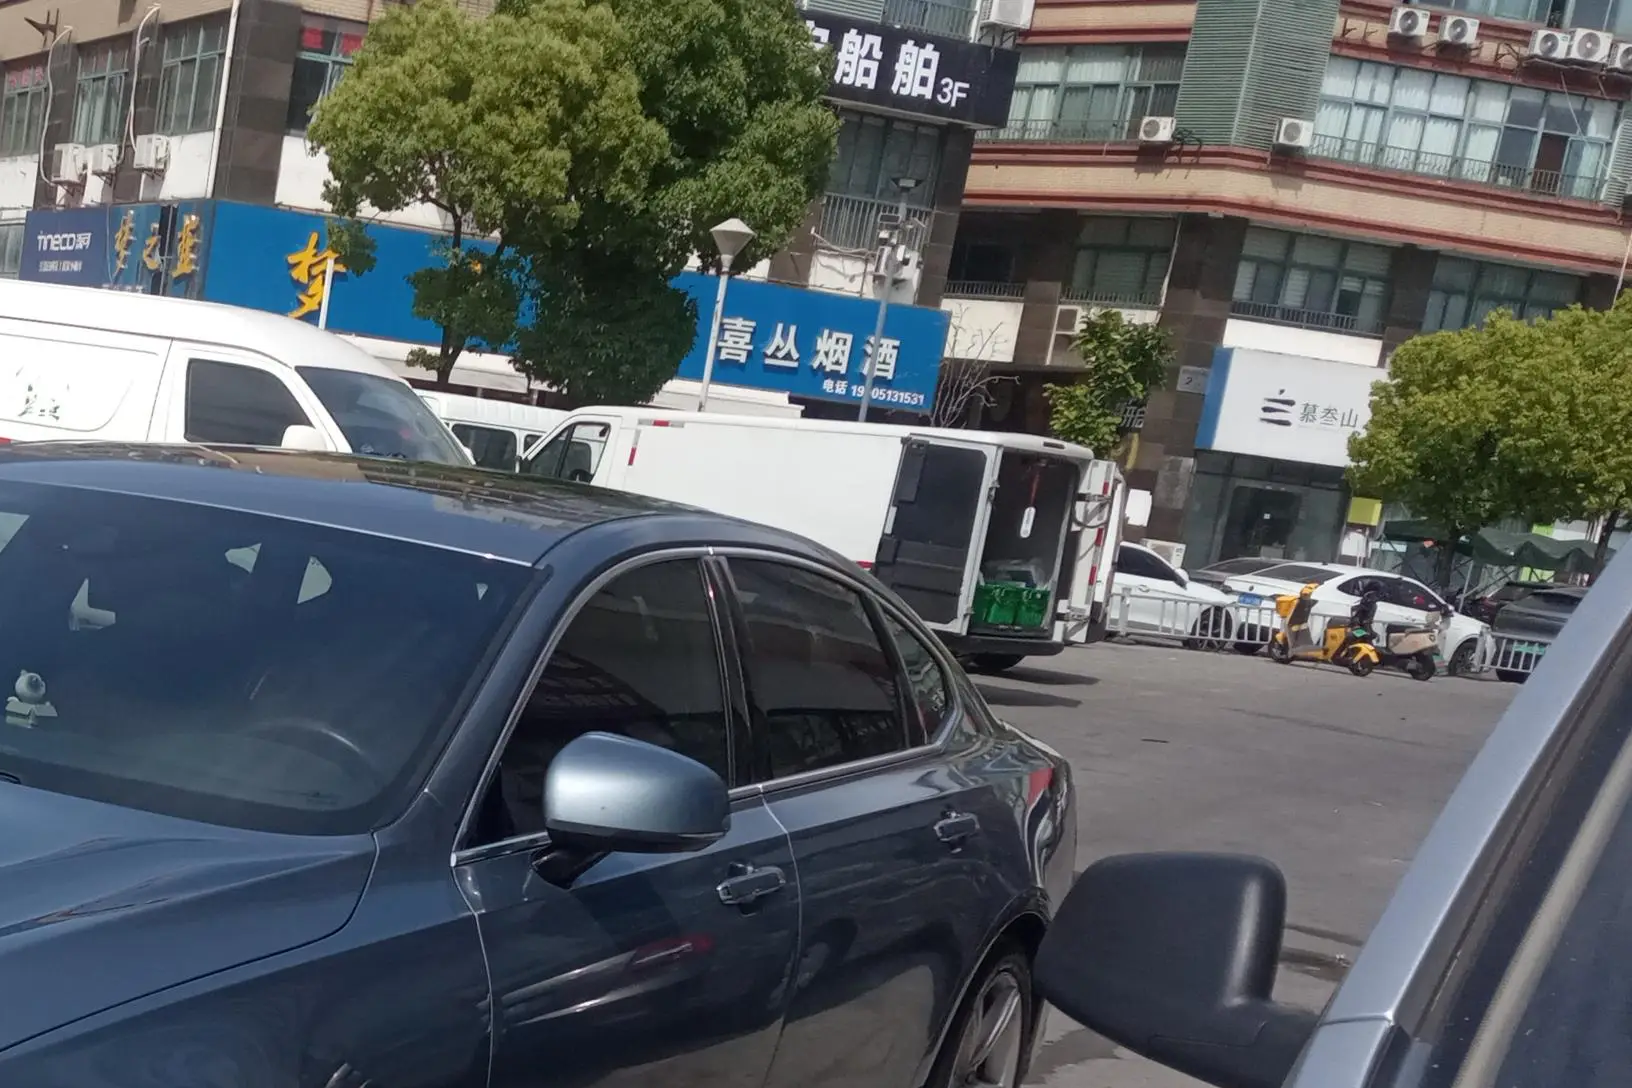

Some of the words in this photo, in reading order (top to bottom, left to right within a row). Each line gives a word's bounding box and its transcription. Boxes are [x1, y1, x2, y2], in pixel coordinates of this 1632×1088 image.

[937, 77, 970, 108] 3F
[717, 316, 901, 381] 喜丛烟酒
[823, 379, 847, 395] 电话
[851, 385, 925, 405] 1905131531
